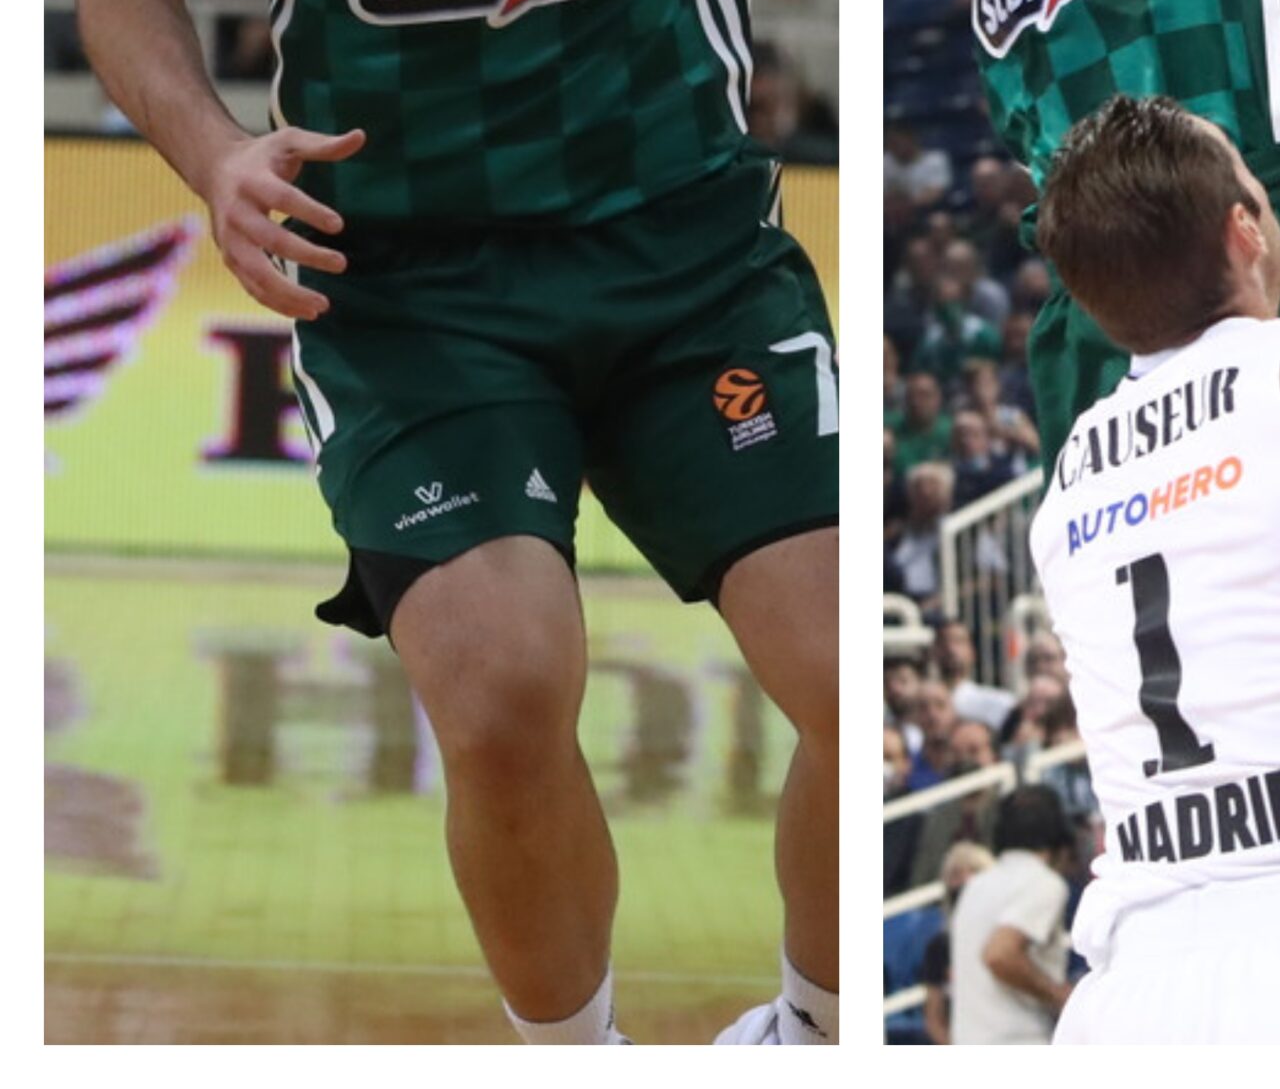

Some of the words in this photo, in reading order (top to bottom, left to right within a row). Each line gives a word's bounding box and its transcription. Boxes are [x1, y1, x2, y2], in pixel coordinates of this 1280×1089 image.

[768, 331, 839, 437] 7
[1058, 367, 1240, 492] CAUSEUR
[1067, 456, 1243, 558] AUTOHERO
[1115, 552, 1215, 777] 1
